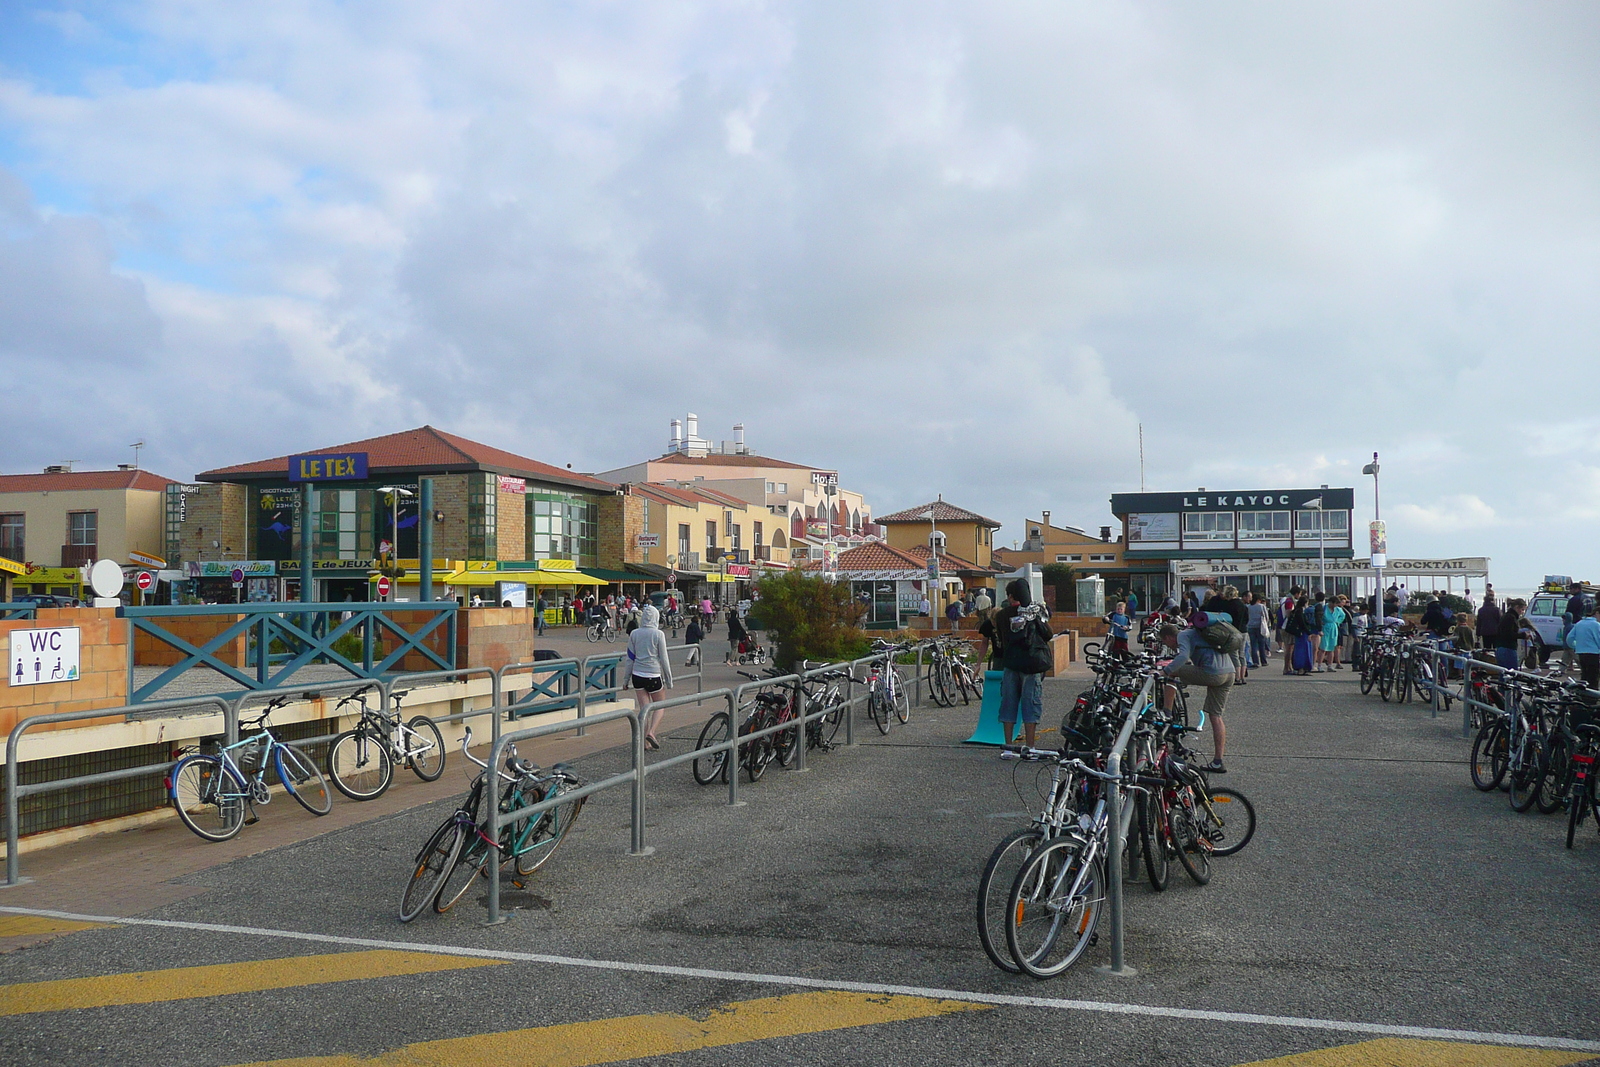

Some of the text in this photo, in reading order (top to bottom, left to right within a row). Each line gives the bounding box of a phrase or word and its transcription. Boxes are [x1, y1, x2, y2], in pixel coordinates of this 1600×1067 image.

[300, 456, 355, 478] LE TEX
[180, 485, 200, 493] NIGHT
[1183, 495, 1289, 507] LE KAYOC
[281, 560, 373, 570] SAE de JEUX
[1211, 564, 1240, 573] BAR
[1393, 561, 1467, 569] COCKTAIL
[29, 631, 62, 652] WC
